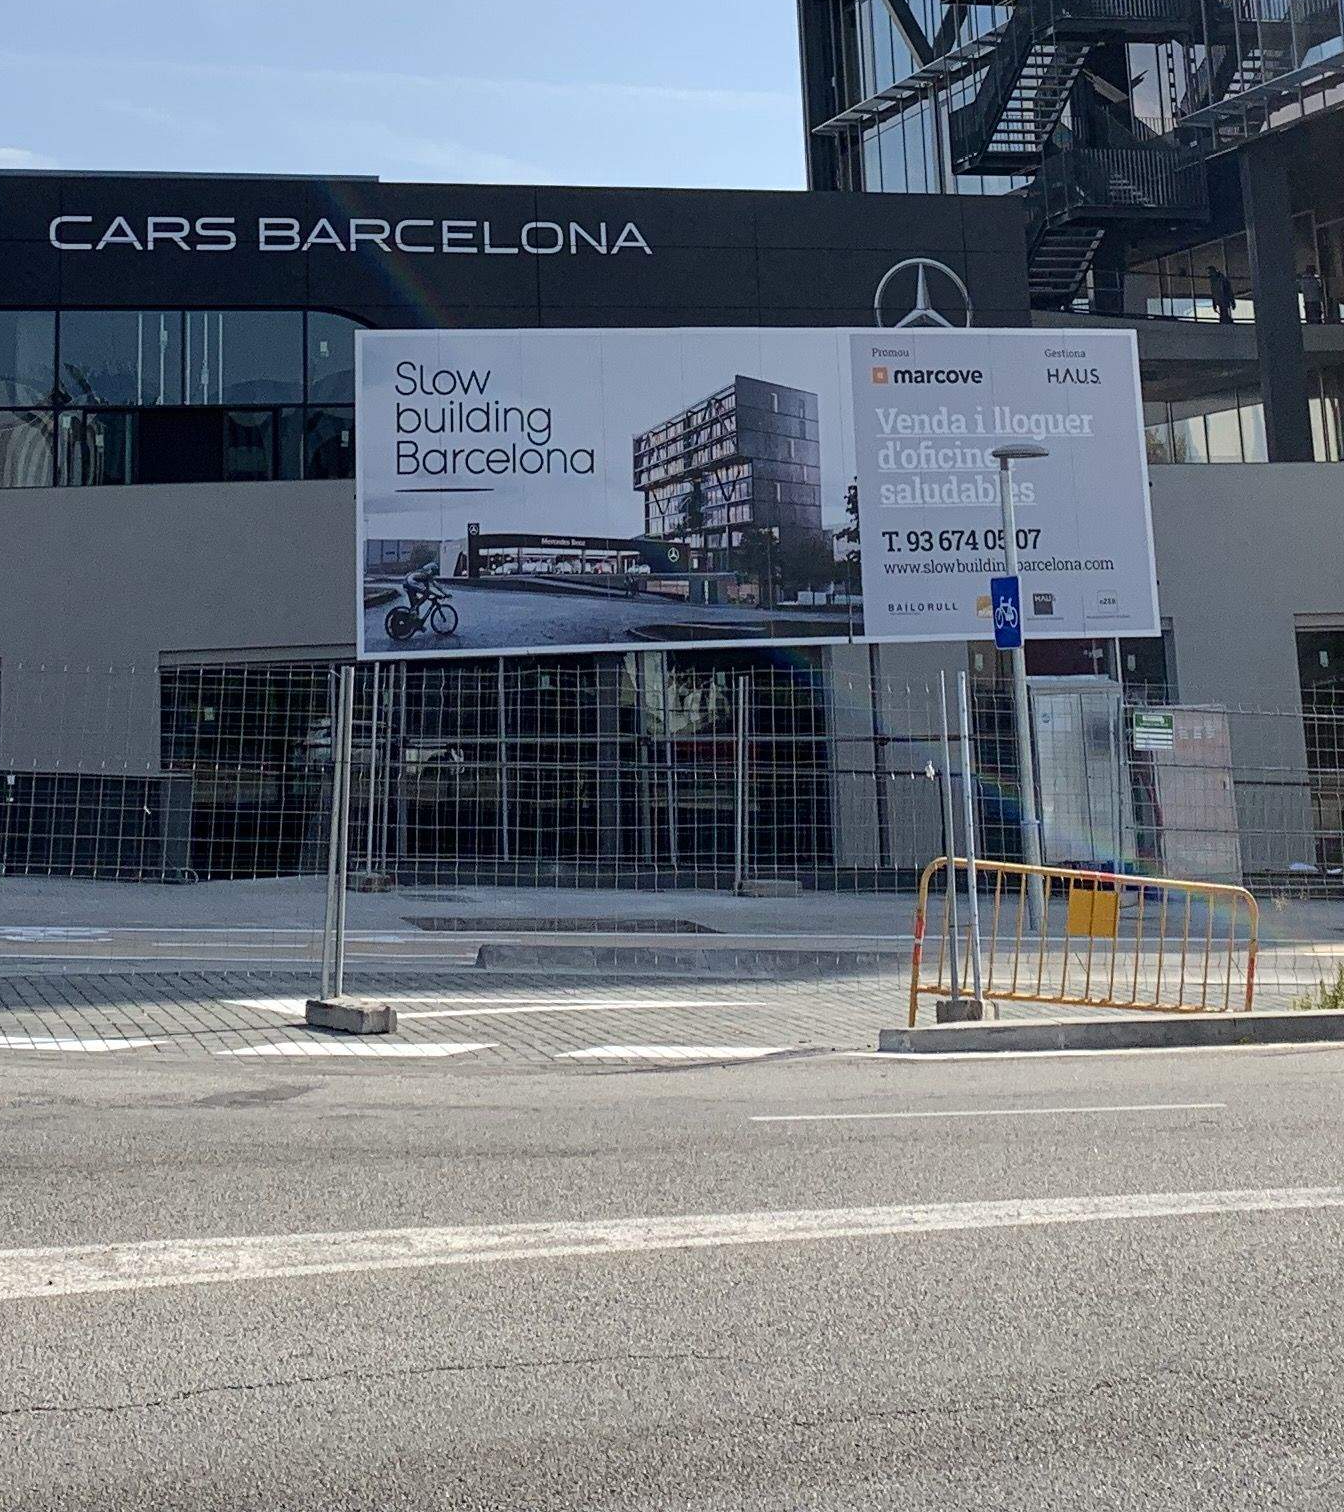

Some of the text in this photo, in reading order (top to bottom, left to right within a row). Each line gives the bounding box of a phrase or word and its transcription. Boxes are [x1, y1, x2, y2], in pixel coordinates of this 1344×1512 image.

[49, 215, 653, 255] CARS BARCELONA
[871, 347, 910, 358] Promou
[1044, 348, 1086, 359] Gestiona
[395, 361, 491, 396] Slow
[893, 367, 984, 385] marcove
[396, 400, 551, 446] building
[875, 406, 1094, 440] Venda i lloguer
[396, 440, 595, 475] Barcelona
[878, 441, 1014, 469] d'oficine
[882, 530, 902, 553] T.
[906, 530, 934, 552] 93
[939, 529, 979, 552] 674
[1016, 528, 1042, 550] 07
[884, 556, 1114, 575] www.slowbuildinarcelona.com
